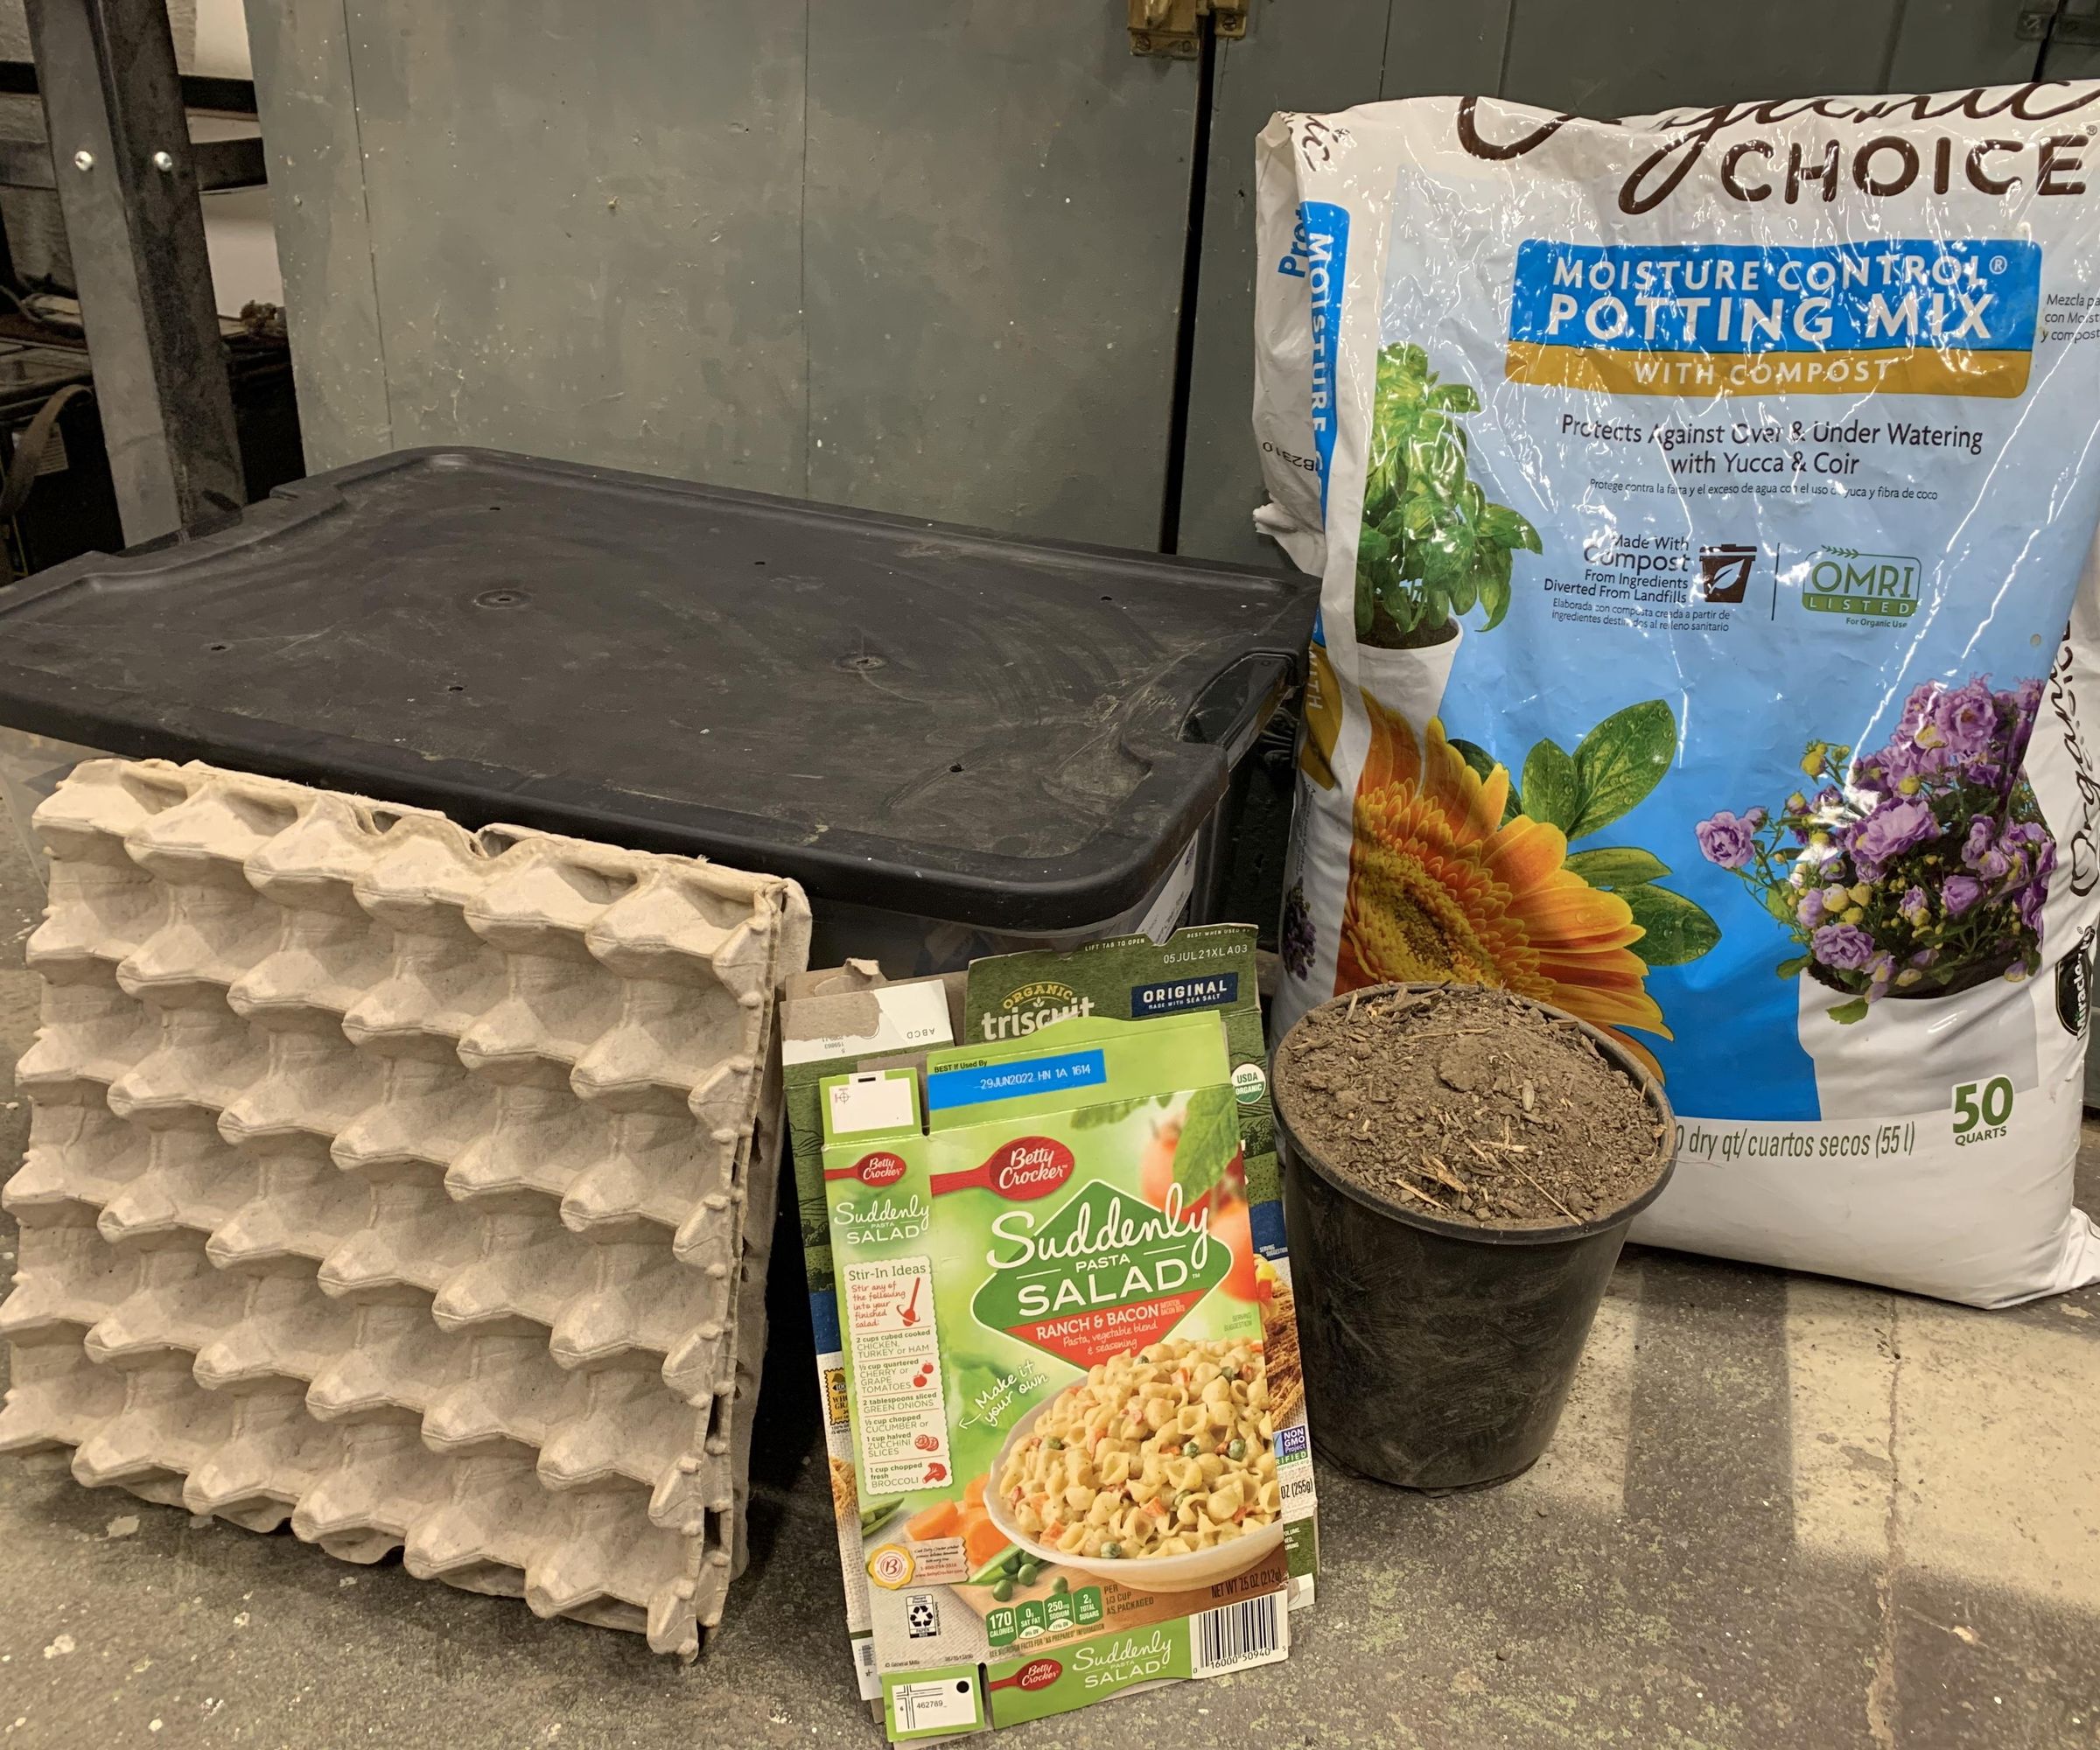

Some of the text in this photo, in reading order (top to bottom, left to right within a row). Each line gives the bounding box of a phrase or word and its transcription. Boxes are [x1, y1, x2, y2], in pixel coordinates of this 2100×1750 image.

[1552, 257, 1760, 290] MOISTURE
[2047, 293, 2084, 305] Mezcla
[1548, 292, 1993, 342] POTTING MIX
[2045, 313, 2065, 323] con
[1634, 359, 1894, 385] WITH COMPOST
[1562, 414, 1983, 455] Protects Against Over Under Watering
[1671, 451, 1859, 474] with Yucca & Coir
[1590, 479, 1623, 493] Protege
[1625, 483, 1654, 493] contra
[1708, 486, 1739, 494] exceso
[1755, 486, 1778, 496] agua
[1812, 486, 1828, 495] uso
[1878, 486, 1900, 498] fibra
[1902, 486, 1914, 498] de
[1917, 490, 1937, 500] coco
[1655, 536, 1689, 550] With
[1585, 569, 1688, 590] From Ingredients
[1812, 561, 1914, 598] OMRI
[1544, 578, 1686, 603] Diverted From Landfills
[1810, 597, 1909, 613] LISTED
[1860, 618, 1890, 628] Organic
[1893, 620, 1908, 628] Use
[1003, 984, 1073, 1010] ORGANIC
[1143, 979, 1228, 1003] ORIGINAL
[960, 1060, 978, 1069] Used
[980, 1064, 1091, 1089] 29JUN2022 HN 1614
[1236, 1072, 1258, 1083] USDA
[1236, 1084, 1263, 1095] ORGANIC
[1952, 1076, 2012, 1134] 50
[1689, 1125, 1716, 1160] dry
[1819, 1131, 1870, 1157] secos
[1955, 1126, 2006, 1147] QUARTS
[869, 1157, 896, 1171] Betty
[1010, 1147, 1055, 1171] Betty
[834, 1194, 930, 1231] Suddenly
[986, 1182, 1210, 1270] Suddenly
[847, 1225, 920, 1244] SALAD
[1075, 1253, 1130, 1273] PASTA
[849, 1264, 926, 1282] Stir-In Ideas
[851, 1284, 868, 1293] Stir
[869, 1291, 906, 1302] following
[873, 1301, 890, 1312] your
[855, 1309, 887, 1321] finished
[1036, 1304, 1159, 1340] RANCH & BACON
[881, 1333, 903, 1341] cubed
[905, 1329, 930, 1338] cooked
[1062, 1320, 1158, 1348] Pasta, vegetable blend
[858, 1348, 894, 1359] TURKEY
[908, 1344, 929, 1353] HAM
[1096, 1339, 1138, 1353] seasoning
[884, 1358, 919, 1368] quartered
[860, 1368, 897, 1379] CHERRY
[860, 1376, 892, 1387] GRAPE
[862, 1382, 912, 1394] TOMATOES
[975, 1360, 1033, 1409] Make it
[864, 1400, 934, 1414] GREEN ONIONS
[870, 1394, 914, 1405] tablespoons
[984, 1375, 1047, 1427] your own
[889, 1414, 921, 1424] chopped
[865, 1423, 917, 1434] CUCUMBER
[1284, 1428, 1304, 1439] NON
[1284, 1436, 1306, 1447] GMO
[1285, 1444, 1306, 1454] Project
[869, 1448, 900, 1458] SLICES
[1276, 1451, 1306, 1466] RIFIED
[891, 1462, 922, 1472] chopped
[872, 1477, 919, 1488] BROCCOLI
[1280, 1478, 1312, 1499] OZ (255g)
[1104, 1584, 1118, 1594] PER
[1212, 1573, 1260, 1599] NET WT OZ
[1117, 1591, 1131, 1601] CUP
[1117, 1596, 1154, 1614] PACKAGED
[990, 1611, 1012, 1629] 170
[1020, 1617, 1041, 1628] SAT FAT
[1049, 1610, 1070, 1620] SODIUM
[1079, 1610, 1099, 1620] SUGARS
[990, 1628, 1014, 1638] CALORIES
[1072, 1630, 1172, 1671] Suddenly
[1211, 1648, 1270, 1670] 16000 50940
[1028, 1663, 1053, 1676] Betty
[1085, 1661, 1161, 1689] SALAD
[1022, 1671, 1058, 1686] Crocker
